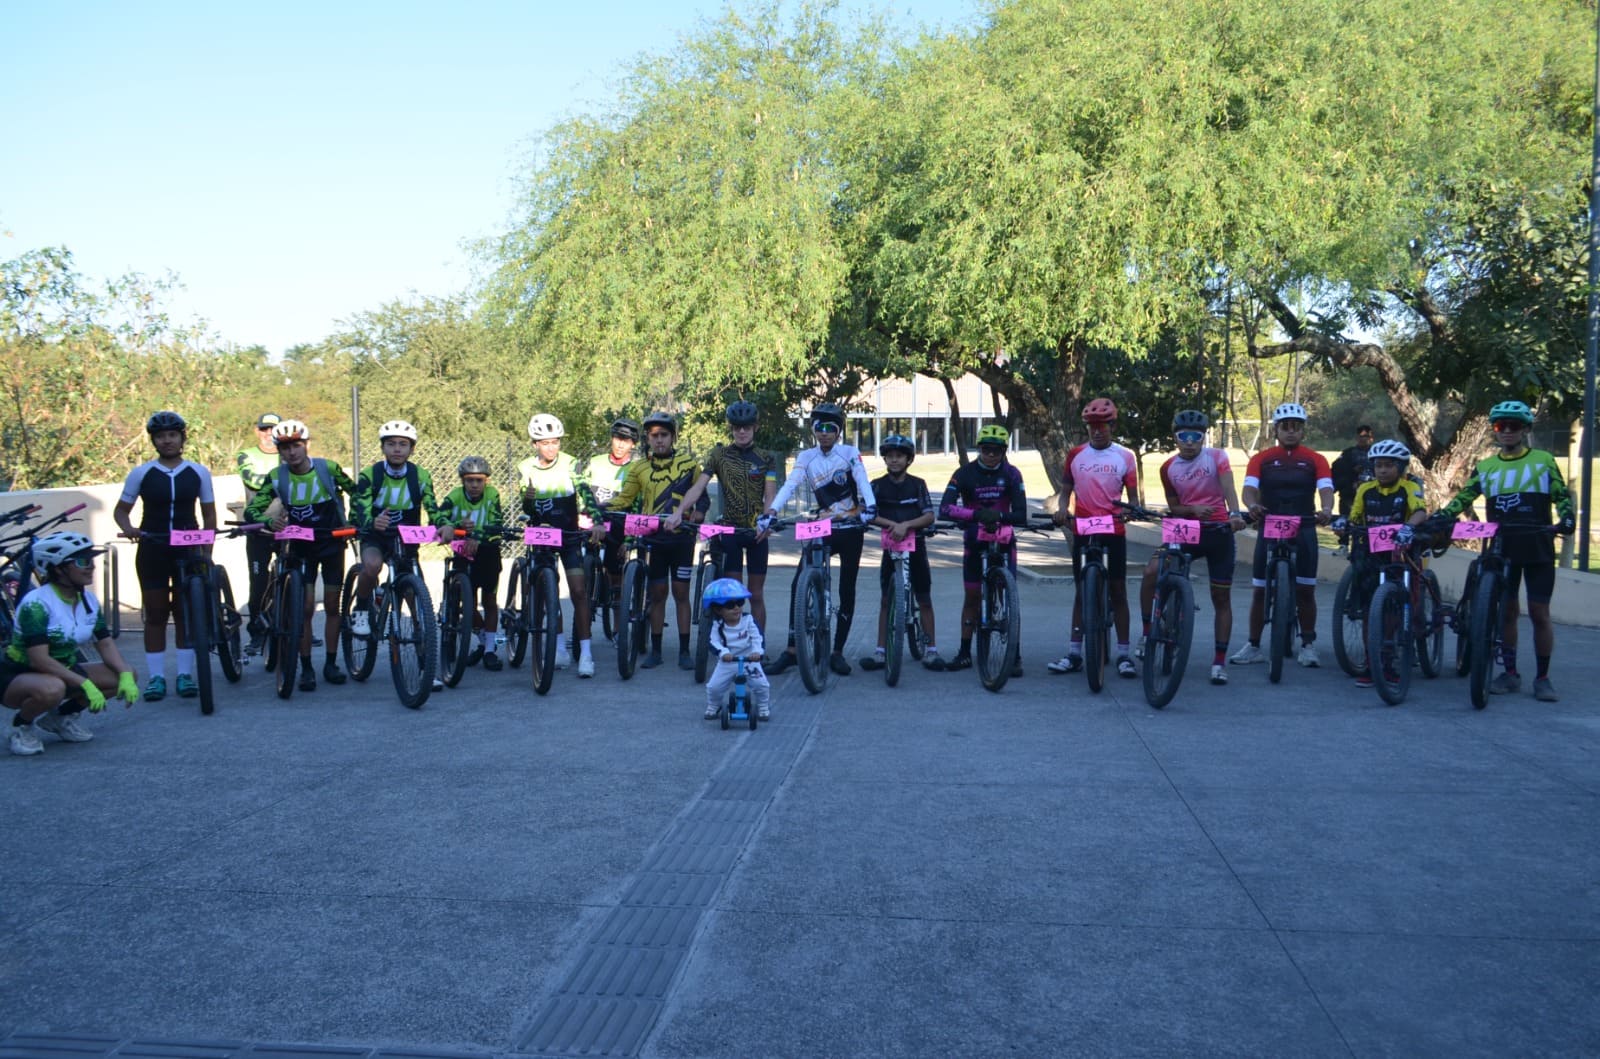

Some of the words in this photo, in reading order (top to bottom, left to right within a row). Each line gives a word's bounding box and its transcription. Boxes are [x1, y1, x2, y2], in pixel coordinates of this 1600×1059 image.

[1087, 518, 1103, 527] 12
[1274, 520, 1291, 531] 43
[807, 524, 821, 534] 15
[1173, 523, 1190, 536] 41
[1465, 523, 1485, 532] 24
[183, 533, 203, 542] 03
[410, 529, 427, 538] 11
[535, 531, 551, 540] 25
